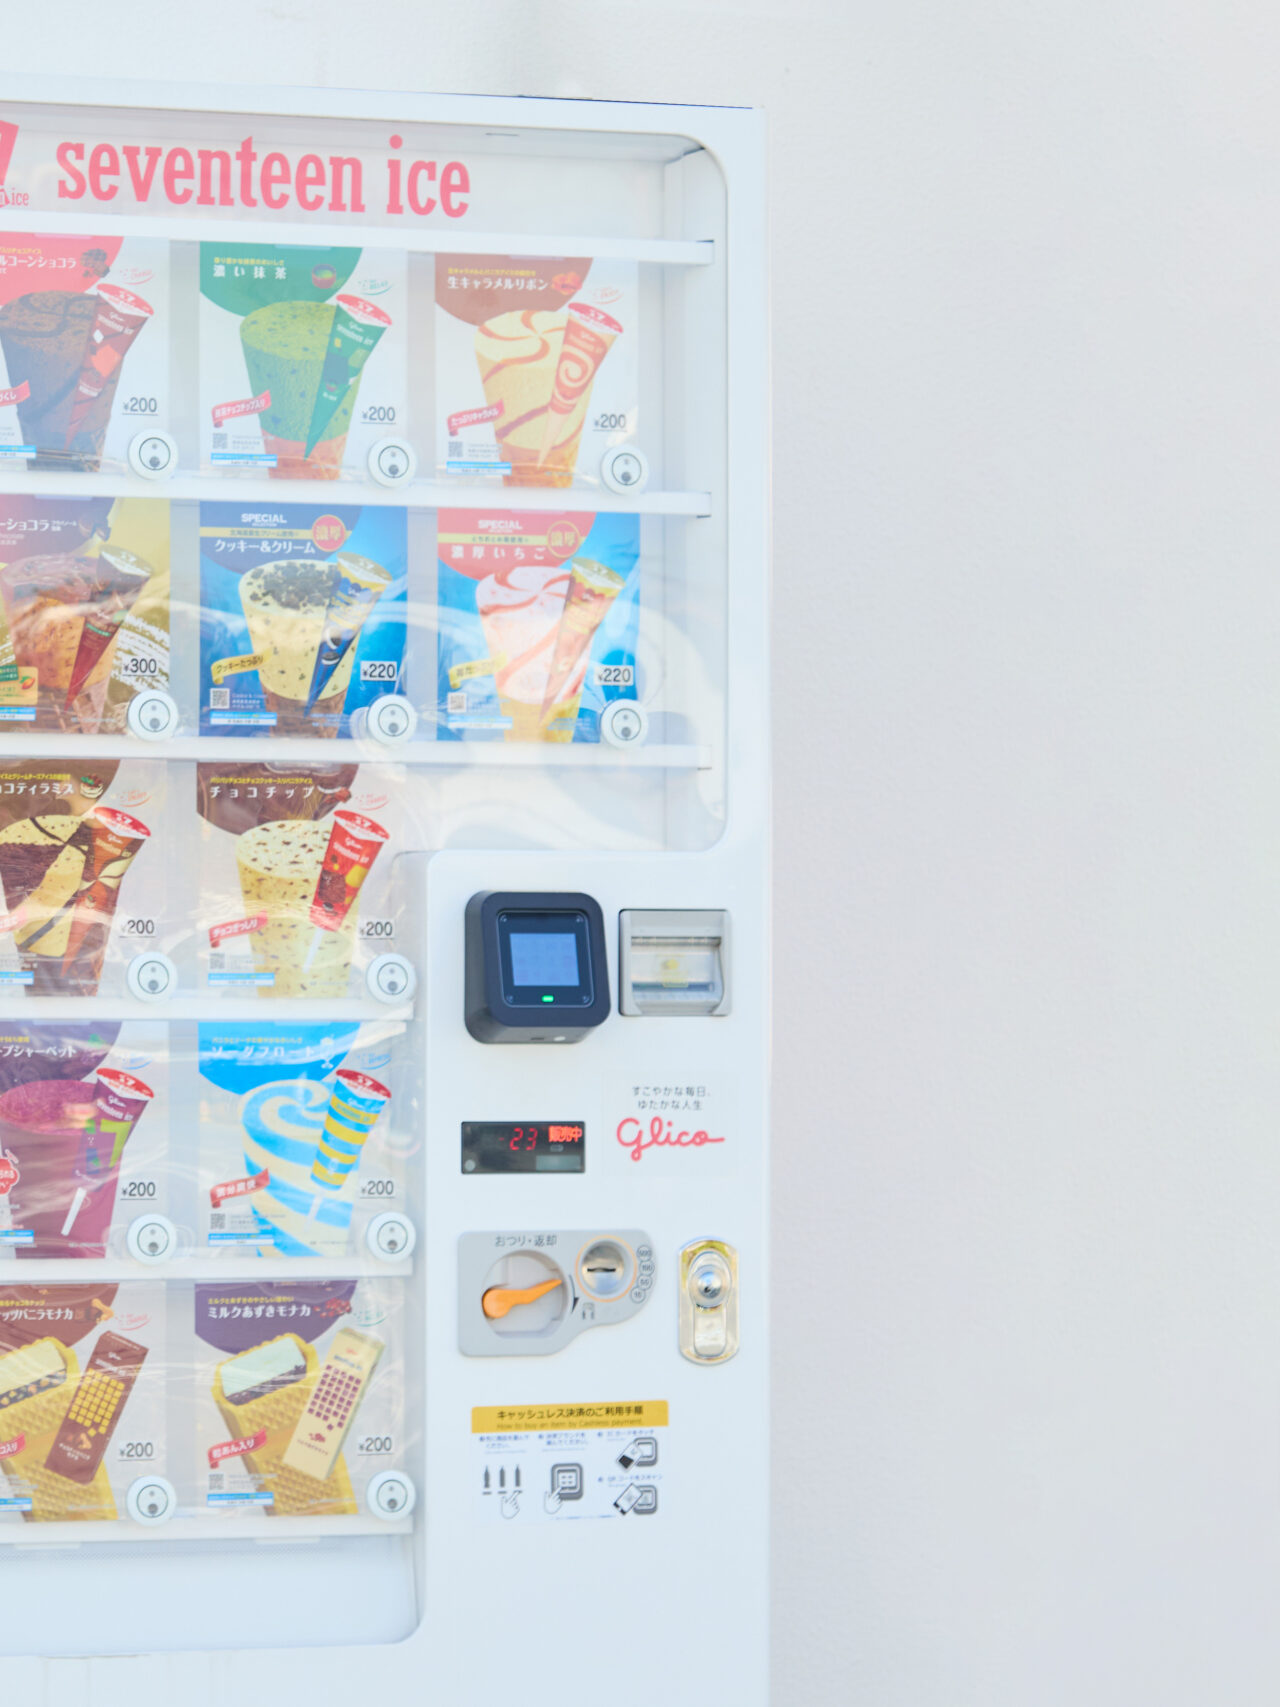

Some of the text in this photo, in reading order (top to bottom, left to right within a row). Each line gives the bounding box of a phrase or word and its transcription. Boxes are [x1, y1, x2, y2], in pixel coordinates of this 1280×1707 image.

[57, 135, 471, 218] seventeen ice
[213, 264, 287, 280] 濃い抹茶
[447, 276, 548, 290] 生キャラメルリボン
[123, 397, 157, 412] ¥200
[362, 406, 396, 421] ¥200
[594, 414, 627, 429] ¥200
[241, 513, 287, 524] SPECIAL
[478, 520, 523, 530] SPECIAL
[215, 540, 316, 554] クッキー&クリーム
[451, 545, 545, 560] 濃厚いちご
[122, 658, 156, 674] ¥300
[363, 664, 396, 679] ¥220
[210, 786, 314, 798] チョコチップ
[361, 921, 393, 936] ¥200
[212, 1046, 315, 1058] ソーダフロート
[638, 1100, 702, 1111] ゆたかな人生
[549, 1125, 583, 1142] 販売中
[122, 1182, 156, 1197] ¥200
[361, 1181, 394, 1195] ¥200
[495, 1235, 557, 1247] おつり・返却
[207, 1305, 311, 1319] ミルクあずきモナカ
[497, 1405, 644, 1420] キャッシュレス決済のご利用手順
[119, 1442, 154, 1457] ¥200
[358, 1437, 392, 1452] ¥200
